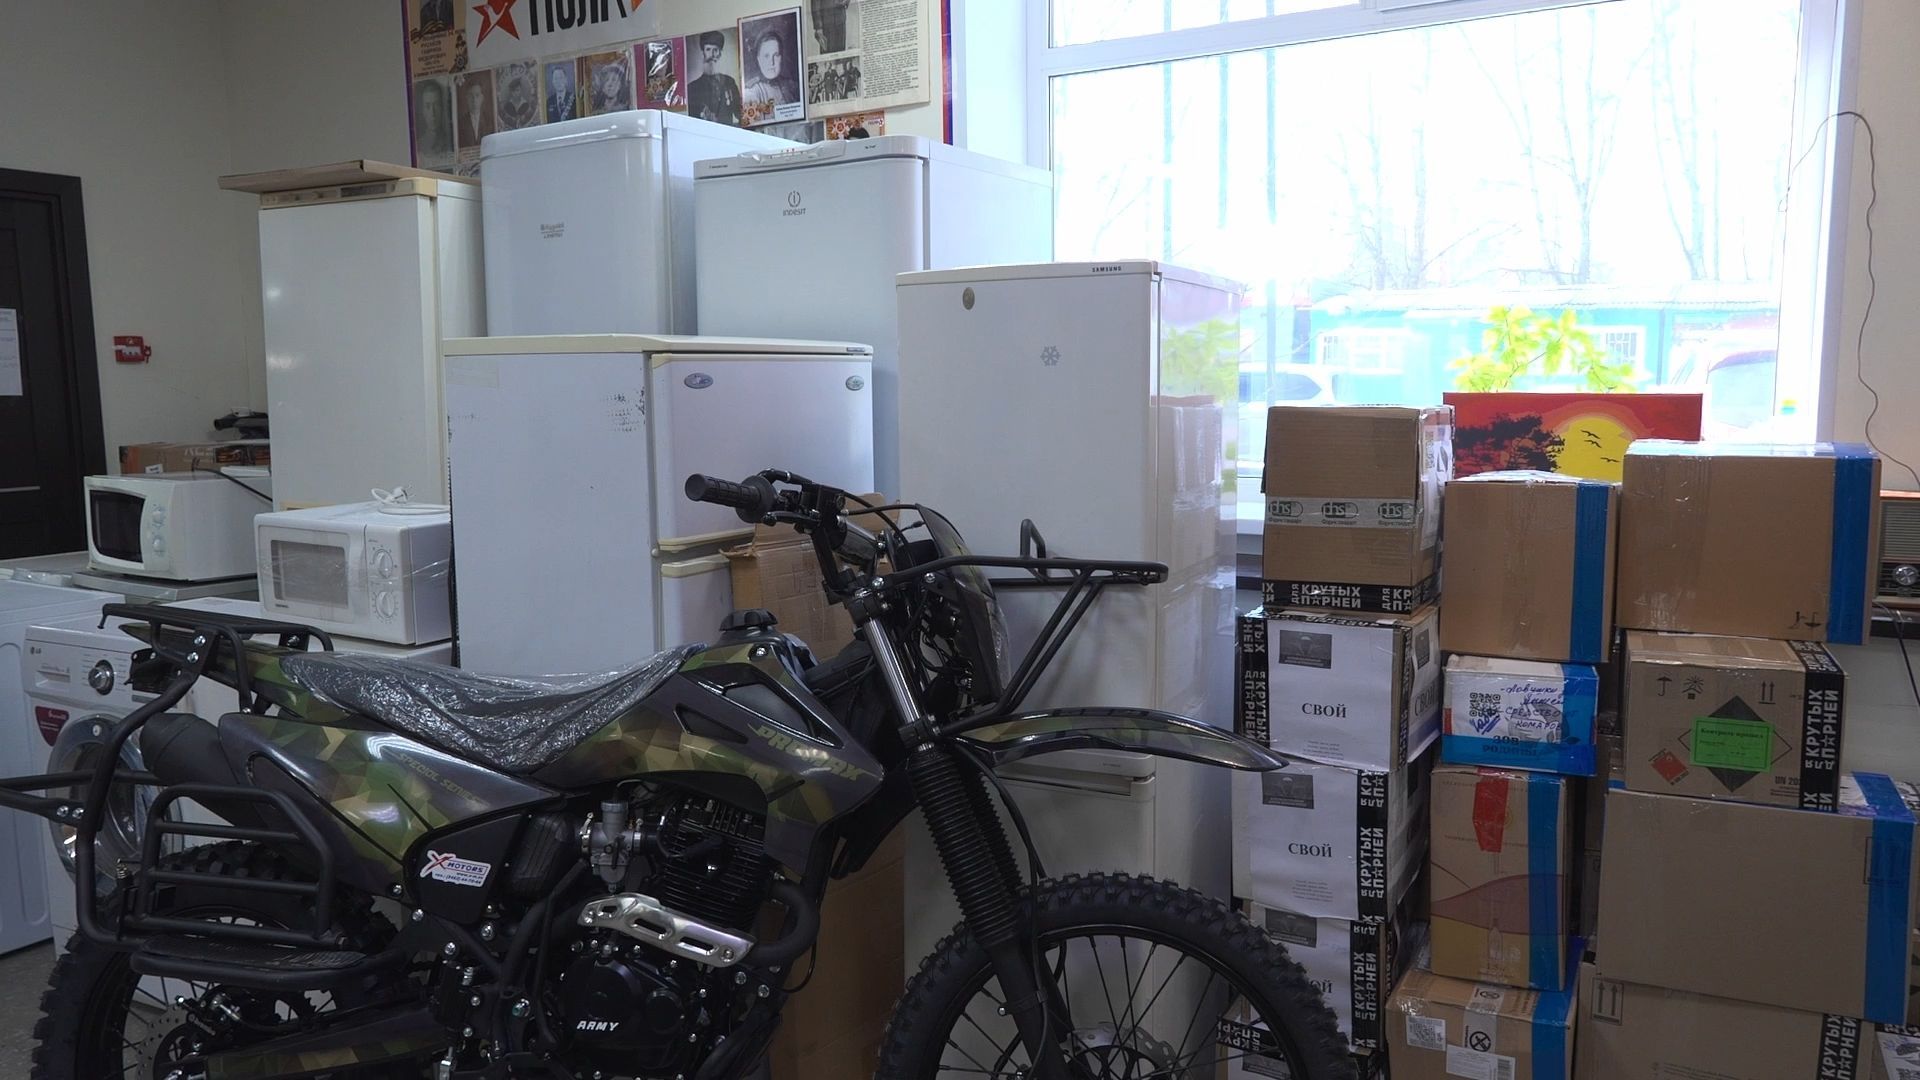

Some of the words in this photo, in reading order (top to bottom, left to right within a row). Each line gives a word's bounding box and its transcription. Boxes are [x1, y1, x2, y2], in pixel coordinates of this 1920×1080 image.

[1301, 584, 1361, 597] КРУТЫХ
[1255, 681, 1267, 742] КРУТЫХ
[1301, 702, 1347, 718] СВОЙ
[1805, 689, 1825, 757] КРУТЫХ
[1805, 759, 1834, 770] ДЛЯ
[1288, 842, 1333, 858] СВОЙ
[1361, 827, 1372, 887] КРУТЫХ
[447, 862, 483, 873] MOTORS
[1361, 890, 1384, 899] ДЛЯ
[1354, 952, 1365, 1010] КРУТЫХ
[576, 1020, 619, 1031] ARMY
